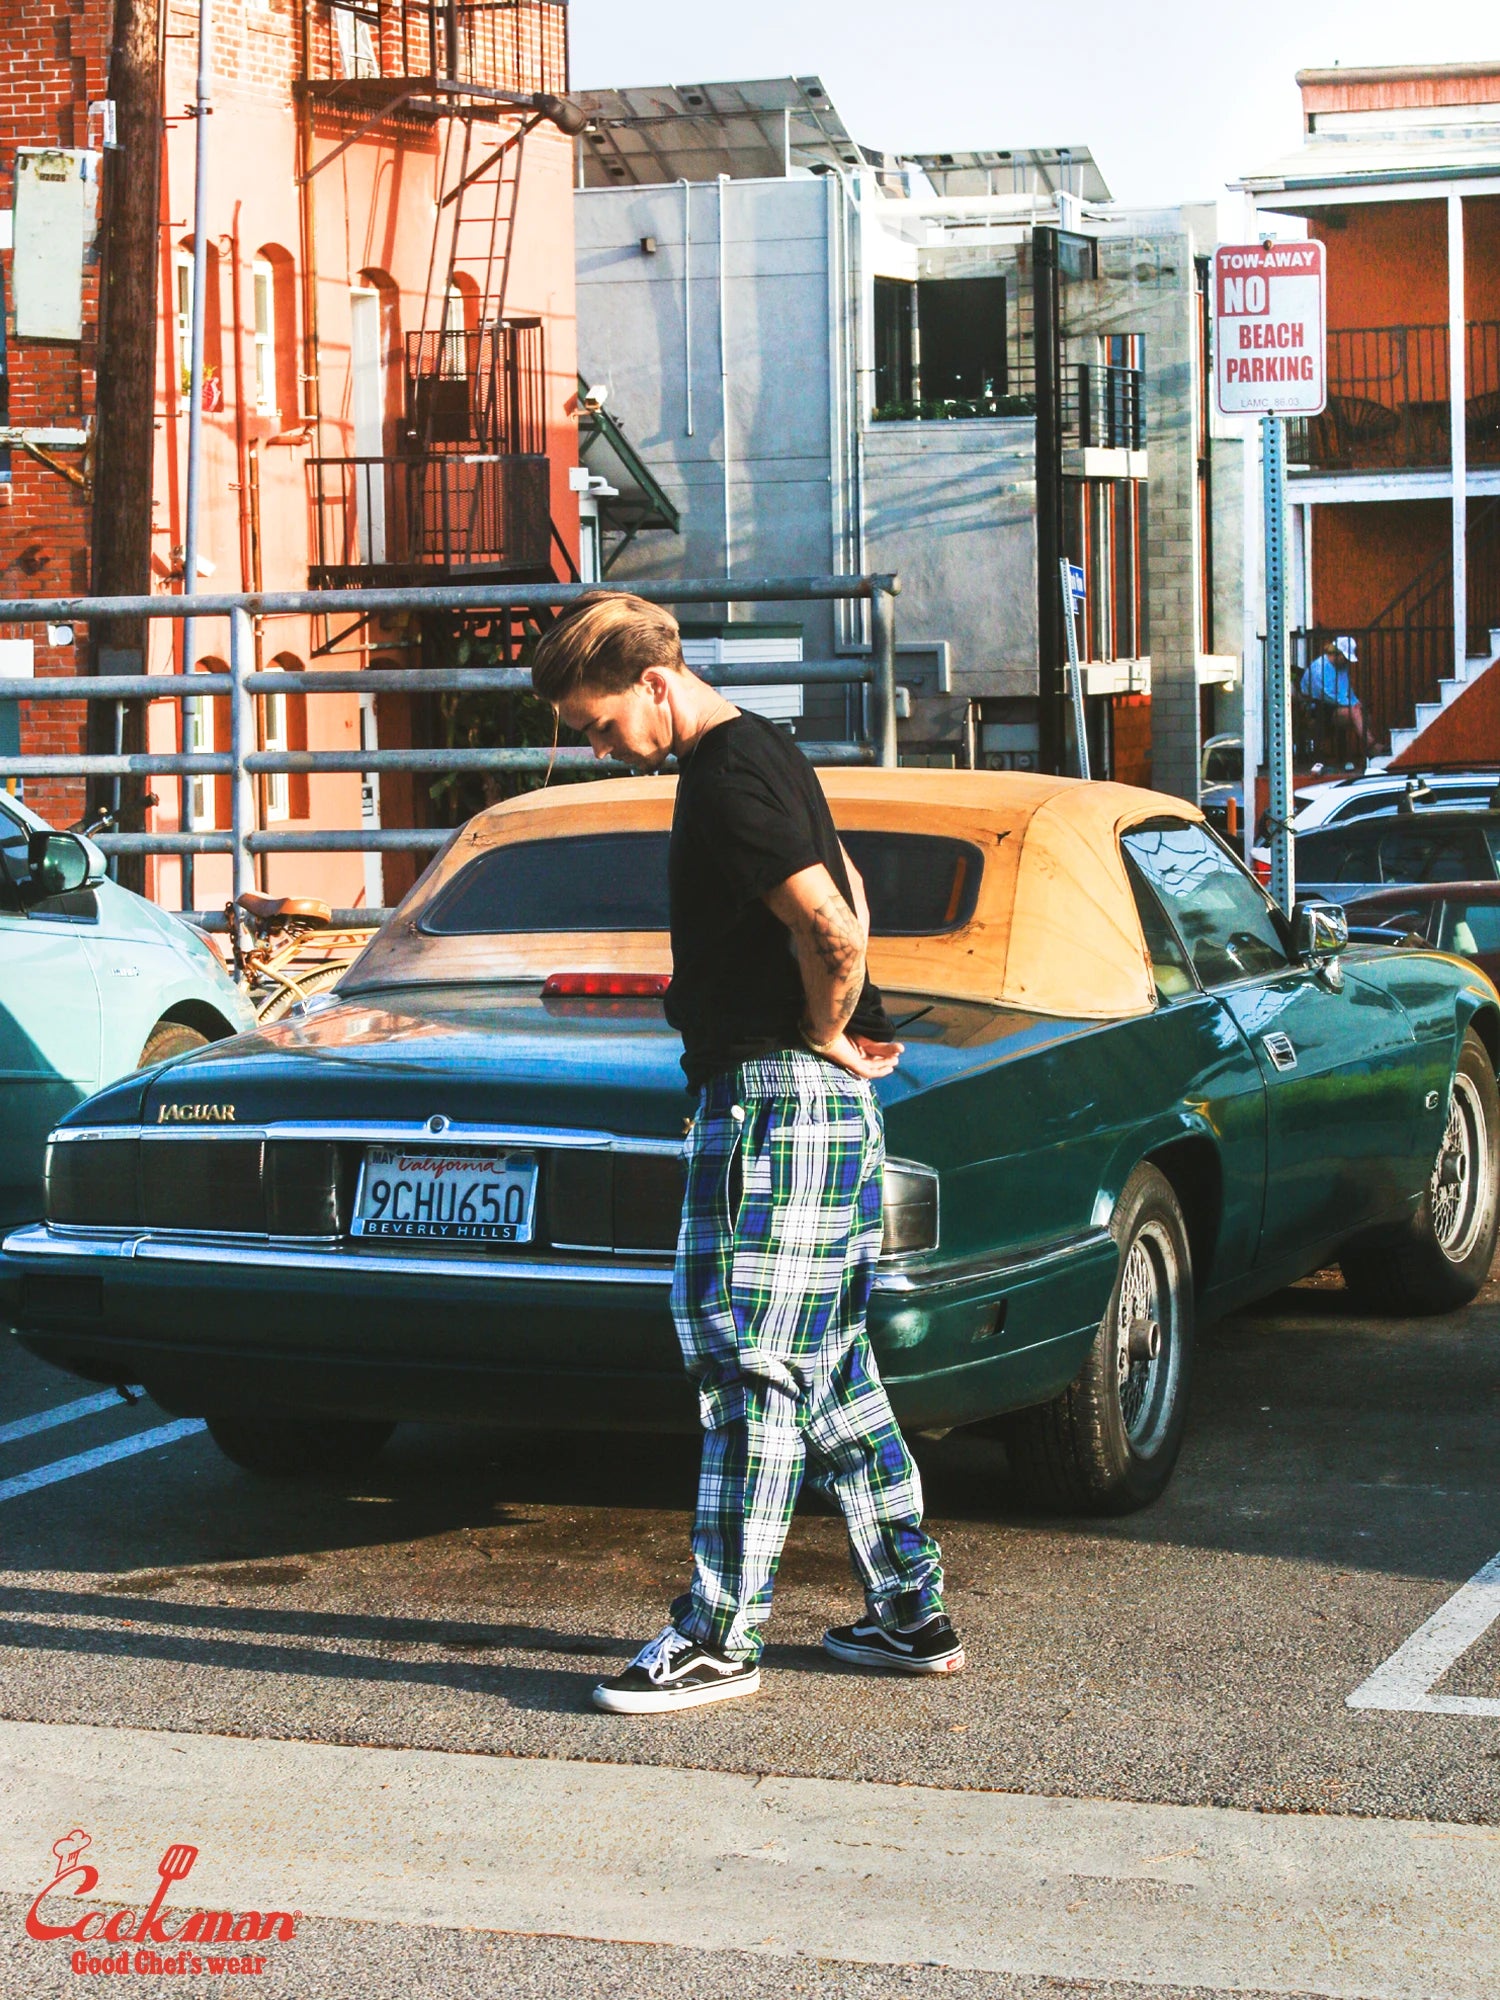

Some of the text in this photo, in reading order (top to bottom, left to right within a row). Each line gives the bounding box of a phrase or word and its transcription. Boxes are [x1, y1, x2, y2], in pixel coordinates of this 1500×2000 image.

[1220, 251, 1314, 270] TOW-AWAY
[1224, 275, 1266, 314] NO
[1239, 322, 1304, 349] BEACH
[1227, 355, 1314, 383] PARKING
[157, 1104, 235, 1124] JAGUAR
[398, 1157, 506, 1179] California
[371, 1179, 525, 1224] 9CHU650
[368, 1223, 511, 1238] BEVERLY HILLS
